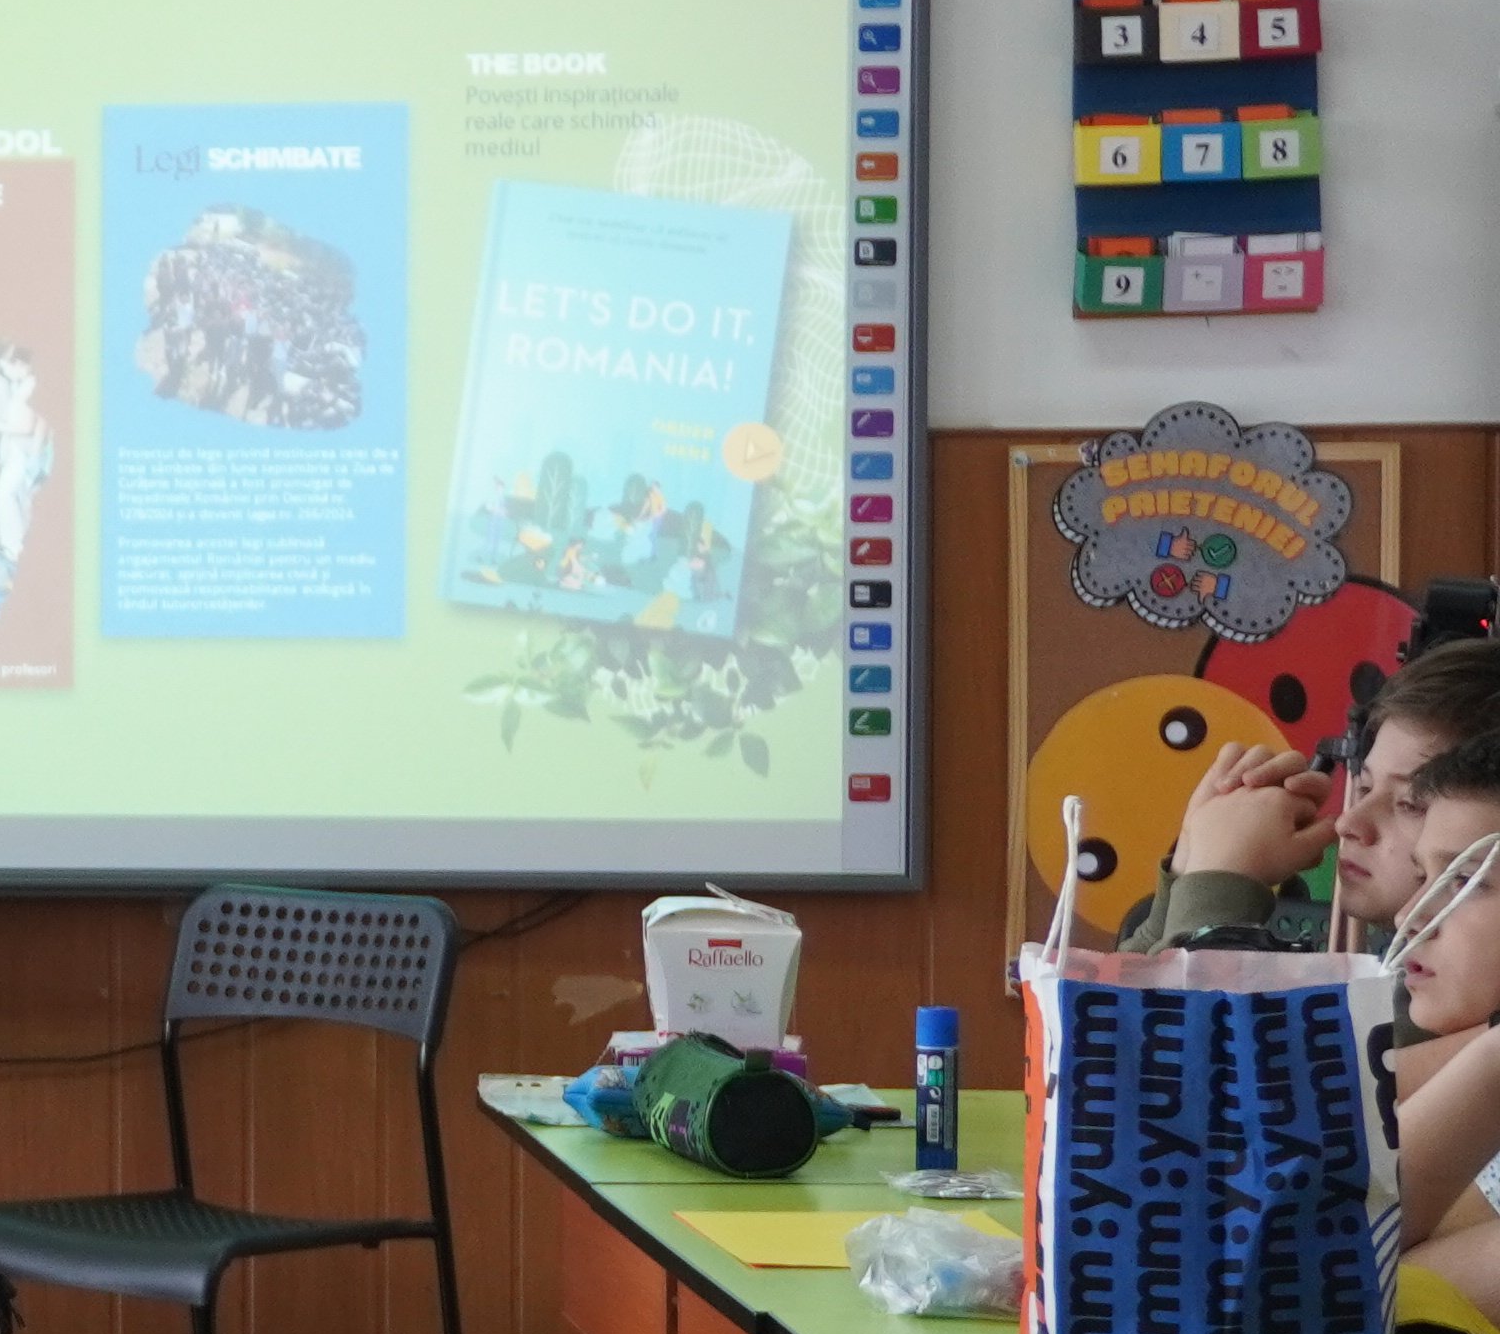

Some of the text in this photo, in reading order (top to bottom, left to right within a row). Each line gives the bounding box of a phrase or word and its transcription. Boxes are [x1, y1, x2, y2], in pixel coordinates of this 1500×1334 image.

[1114, 24, 1129, 48] 3
[1191, 22, 1206, 46] 4
[1271, 17, 1286, 40] 5
[465, 52, 606, 76] THE BOOK
[464, 112, 516, 130] reale
[521, 114, 564, 130] care
[464, 137, 541, 156] mediul
[1112, 145, 1127, 168] 6
[1195, 143, 1210, 166] 7
[1272, 139, 1287, 162] 8
[207, 146, 362, 171] SCHIMBATE
[1115, 273, 1130, 297] 9
[498, 280, 612, 325] LET'S
[628, 295, 695, 334] DO
[505, 332, 734, 392] ROMANIA!
[688, 947, 764, 967] Raffaello
